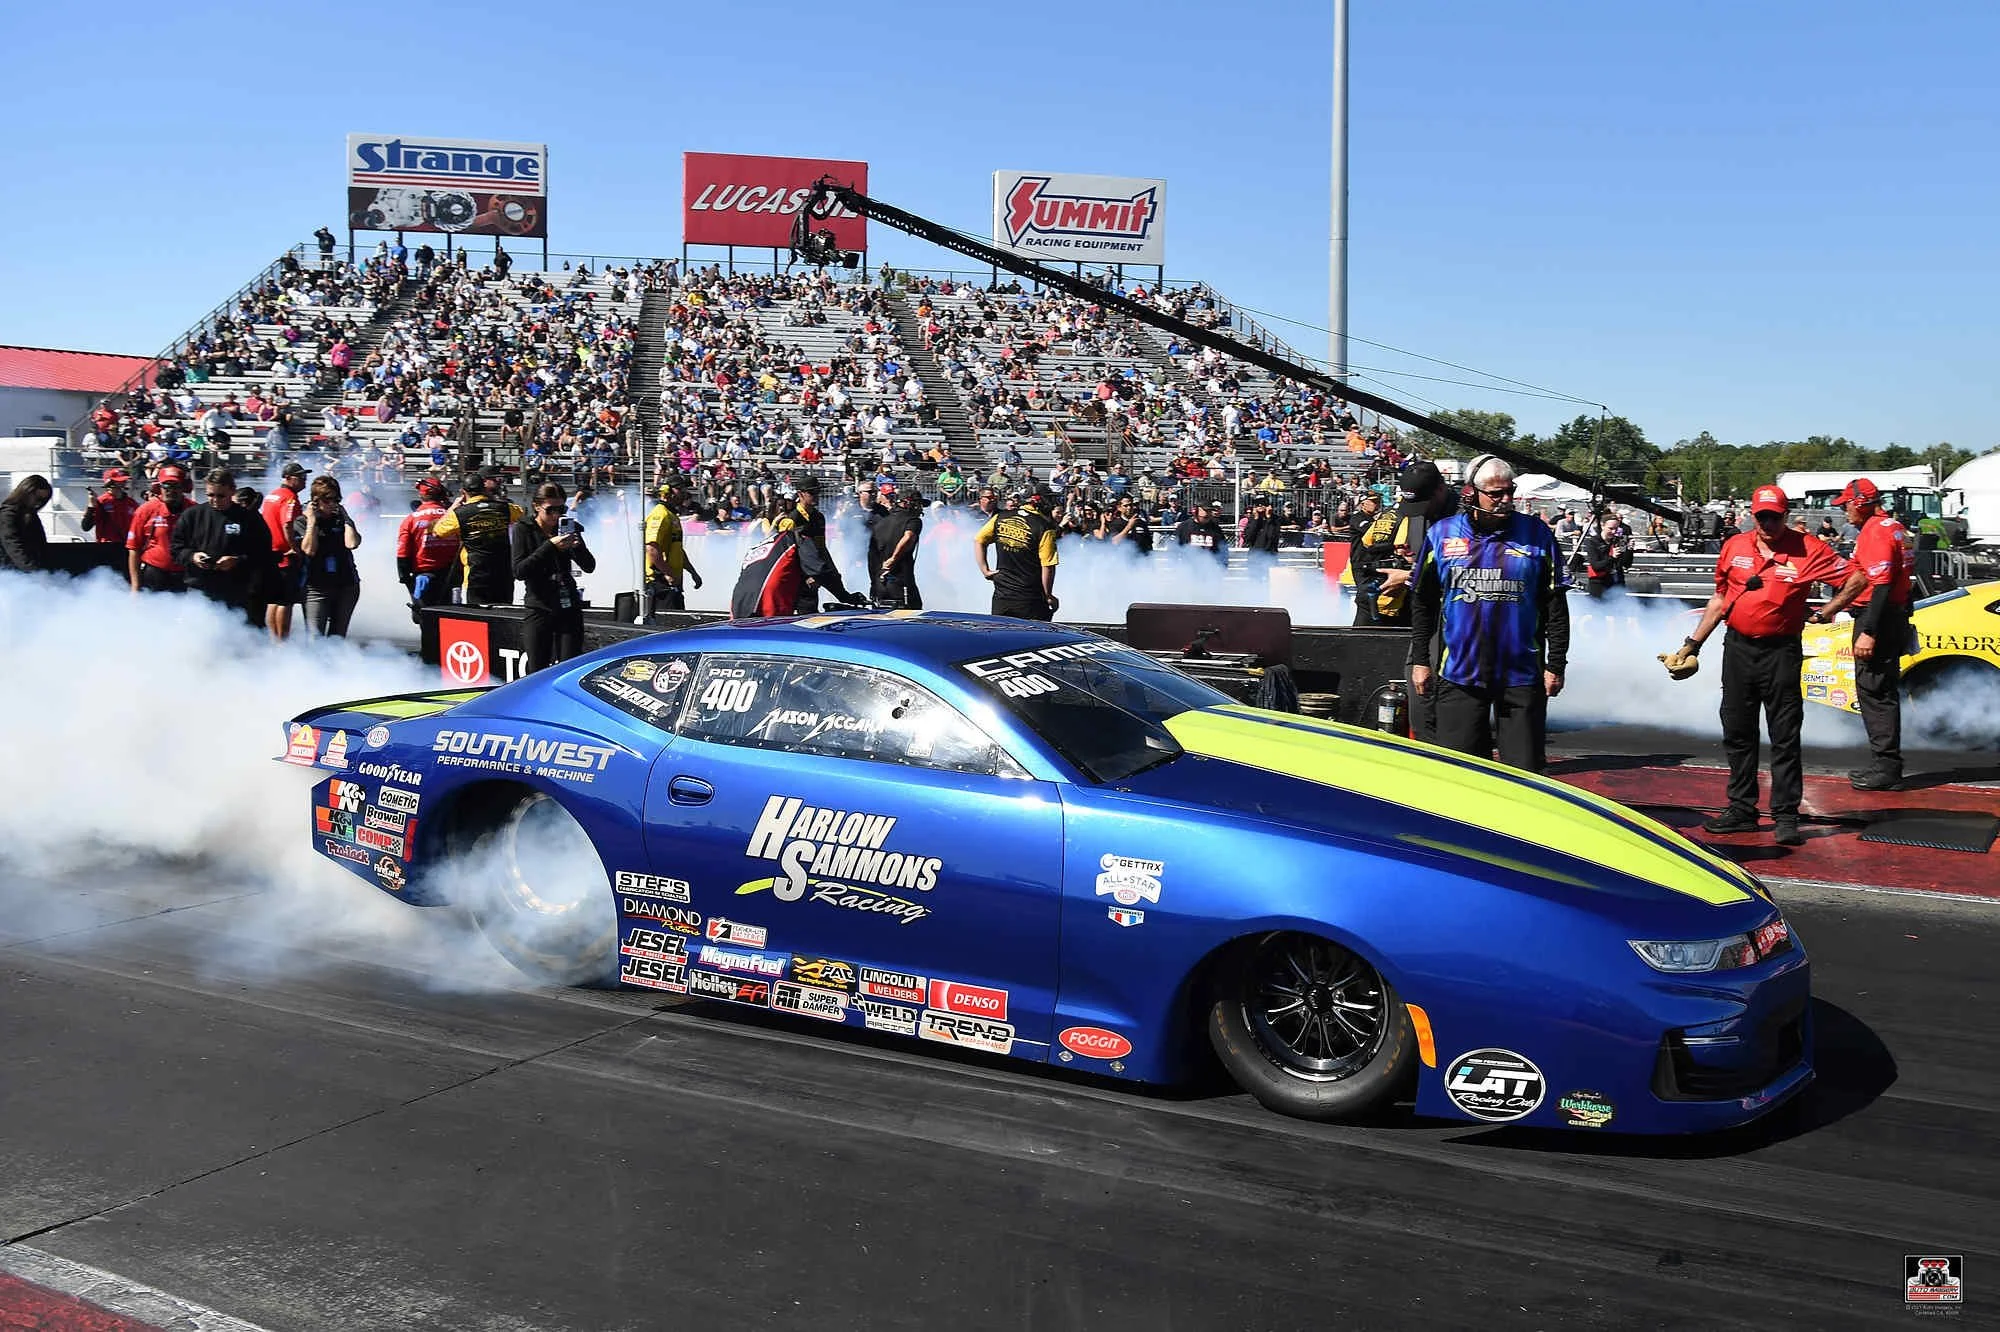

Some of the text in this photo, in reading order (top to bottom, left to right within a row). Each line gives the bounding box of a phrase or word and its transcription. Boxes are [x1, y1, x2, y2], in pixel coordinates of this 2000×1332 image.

[356, 139, 540, 179] Strange
[691, 184, 809, 214] LUCAS
[1026, 238, 1144, 251] RACING EQUIPMENT
[1917, 631, 2000, 655] UADR
[709, 668, 746, 677] PRO
[988, 671, 1019, 682] PRO
[701, 679, 758, 713] 400
[999, 674, 1060, 698] 400
[433, 730, 616, 770] SOUTHWEST
[359, 762, 422, 786] GOODYEAR
[437, 755, 594, 783] PERFORMANCE & MACHINE
[367, 805, 405, 826] Browell
[357, 828, 392, 847] COMP
[746, 795, 897, 861] HARLOW
[773, 840, 942, 901] SAMMONS
[1120, 859, 1161, 871] GETTRX
[620, 873, 686, 894] STEF'S
[1103, 873, 1155, 891] ALL STAR
[624, 898, 702, 926] DIAMOND
[809, 881, 932, 924] Racing
[623, 929, 687, 957] JESEL
[623, 959, 687, 985] JESEL
[700, 946, 786, 975] MagnaFuel
[691, 972, 736, 1000] Holley
[863, 970, 914, 988] LINCOLN
[808, 992, 838, 1005] SUPER
[873, 984, 919, 1000] WELDERS
[954, 993, 999, 1010] DENSO
[802, 1001, 840, 1015] DAMPER
[866, 1002, 917, 1023] WELD
[925, 1013, 1010, 1041] TREND
[1069, 1032, 1120, 1049] FOGGIT
[1449, 1066, 1539, 1096] LAT
[1456, 1093, 1504, 1107] Racing
